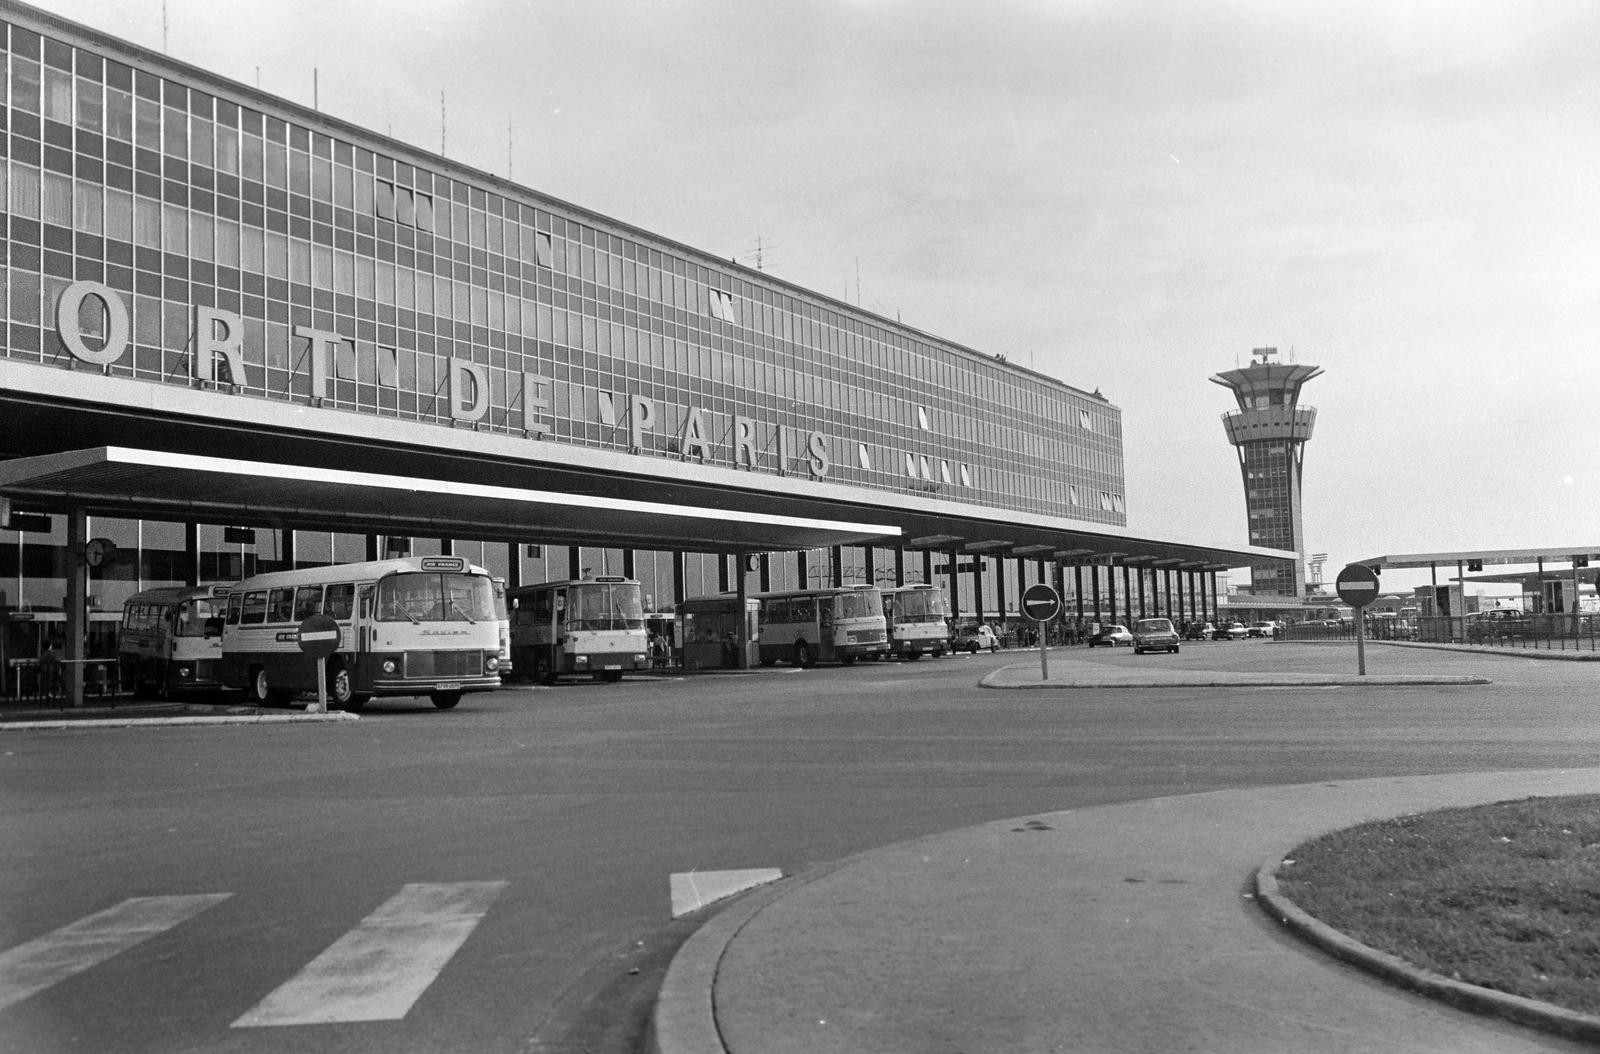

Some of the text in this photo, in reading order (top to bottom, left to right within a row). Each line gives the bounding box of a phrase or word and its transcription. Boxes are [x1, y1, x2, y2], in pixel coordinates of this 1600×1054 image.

[56, 280, 829, 476] ORT DE PARIS
